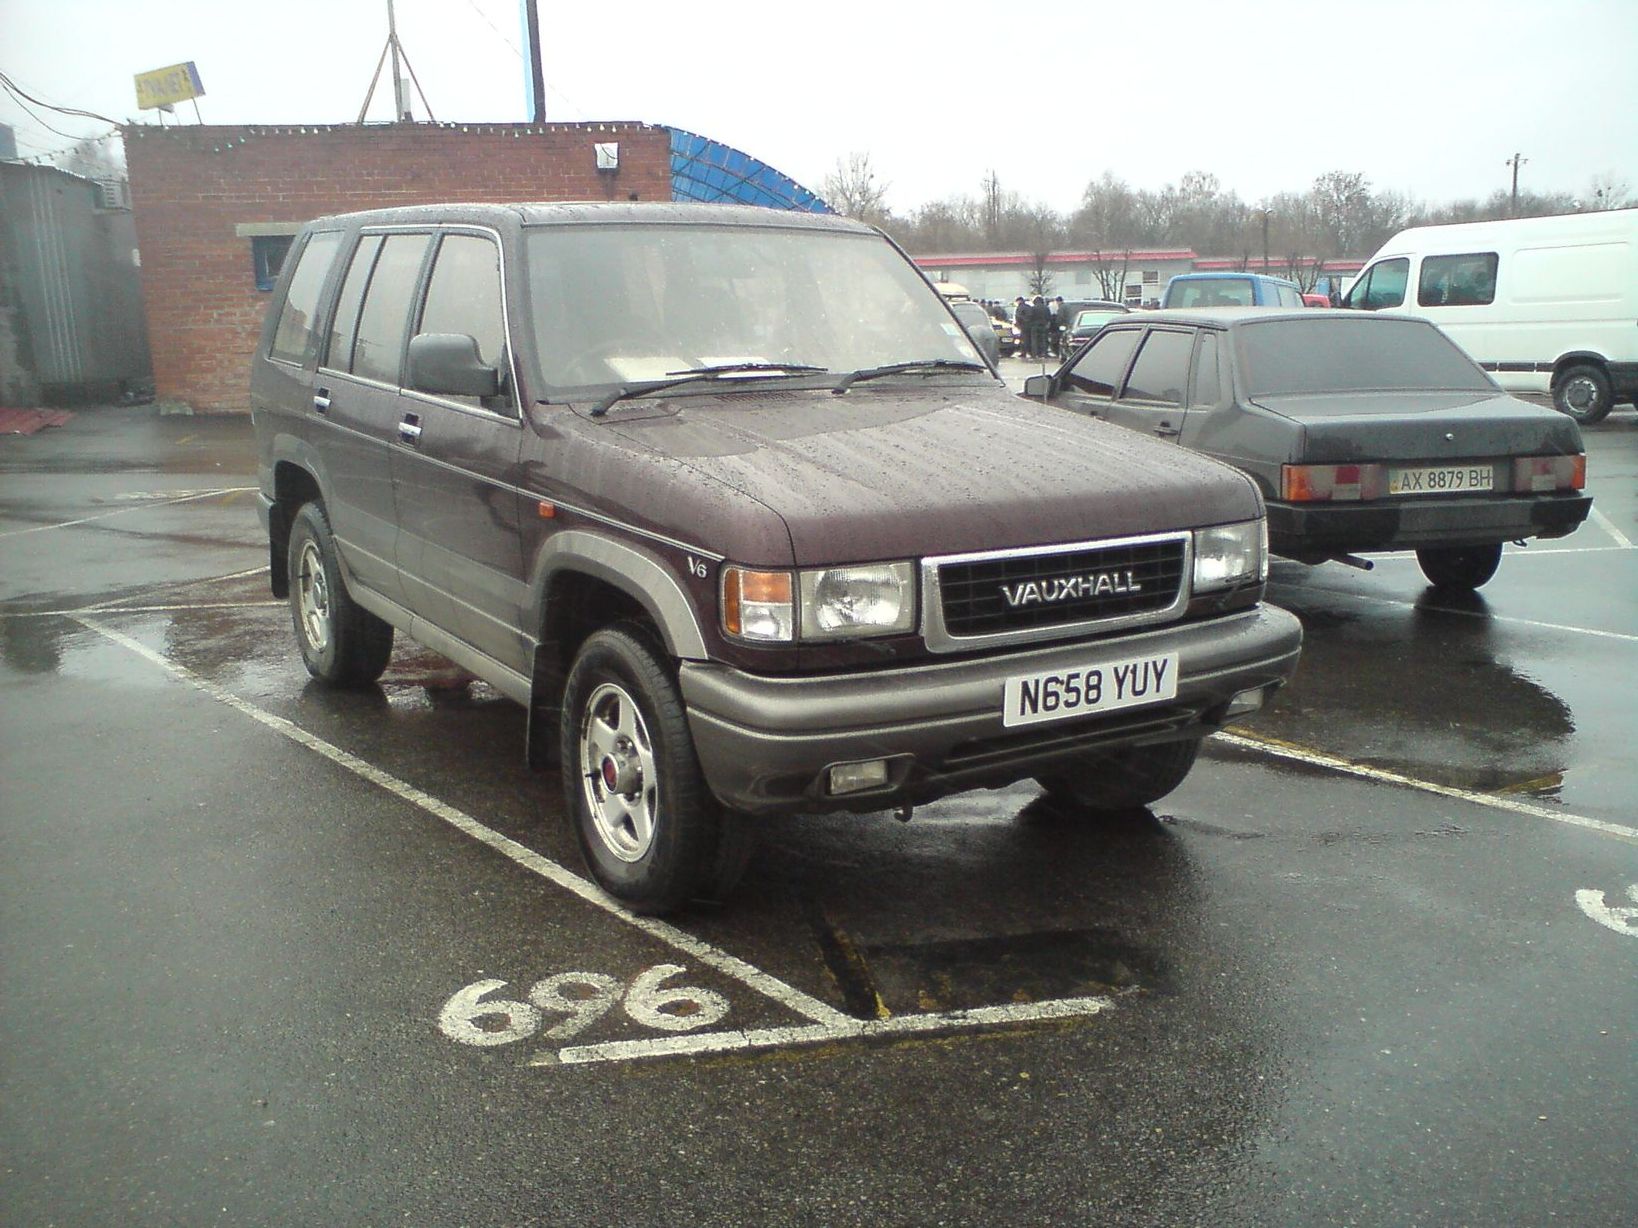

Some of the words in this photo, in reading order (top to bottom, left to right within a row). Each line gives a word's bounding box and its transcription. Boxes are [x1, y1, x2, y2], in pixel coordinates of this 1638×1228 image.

[1401, 471, 1423, 491] AX
[1428, 471, 1465, 489] 8879
[1469, 470, 1491, 487] BH
[687, 555, 708, 578] V6
[1002, 571, 1142, 607] VAUXHALL
[1020, 669, 1102, 716] N658
[1113, 658, 1168, 700] YUY
[438, 964, 731, 1047] 696
